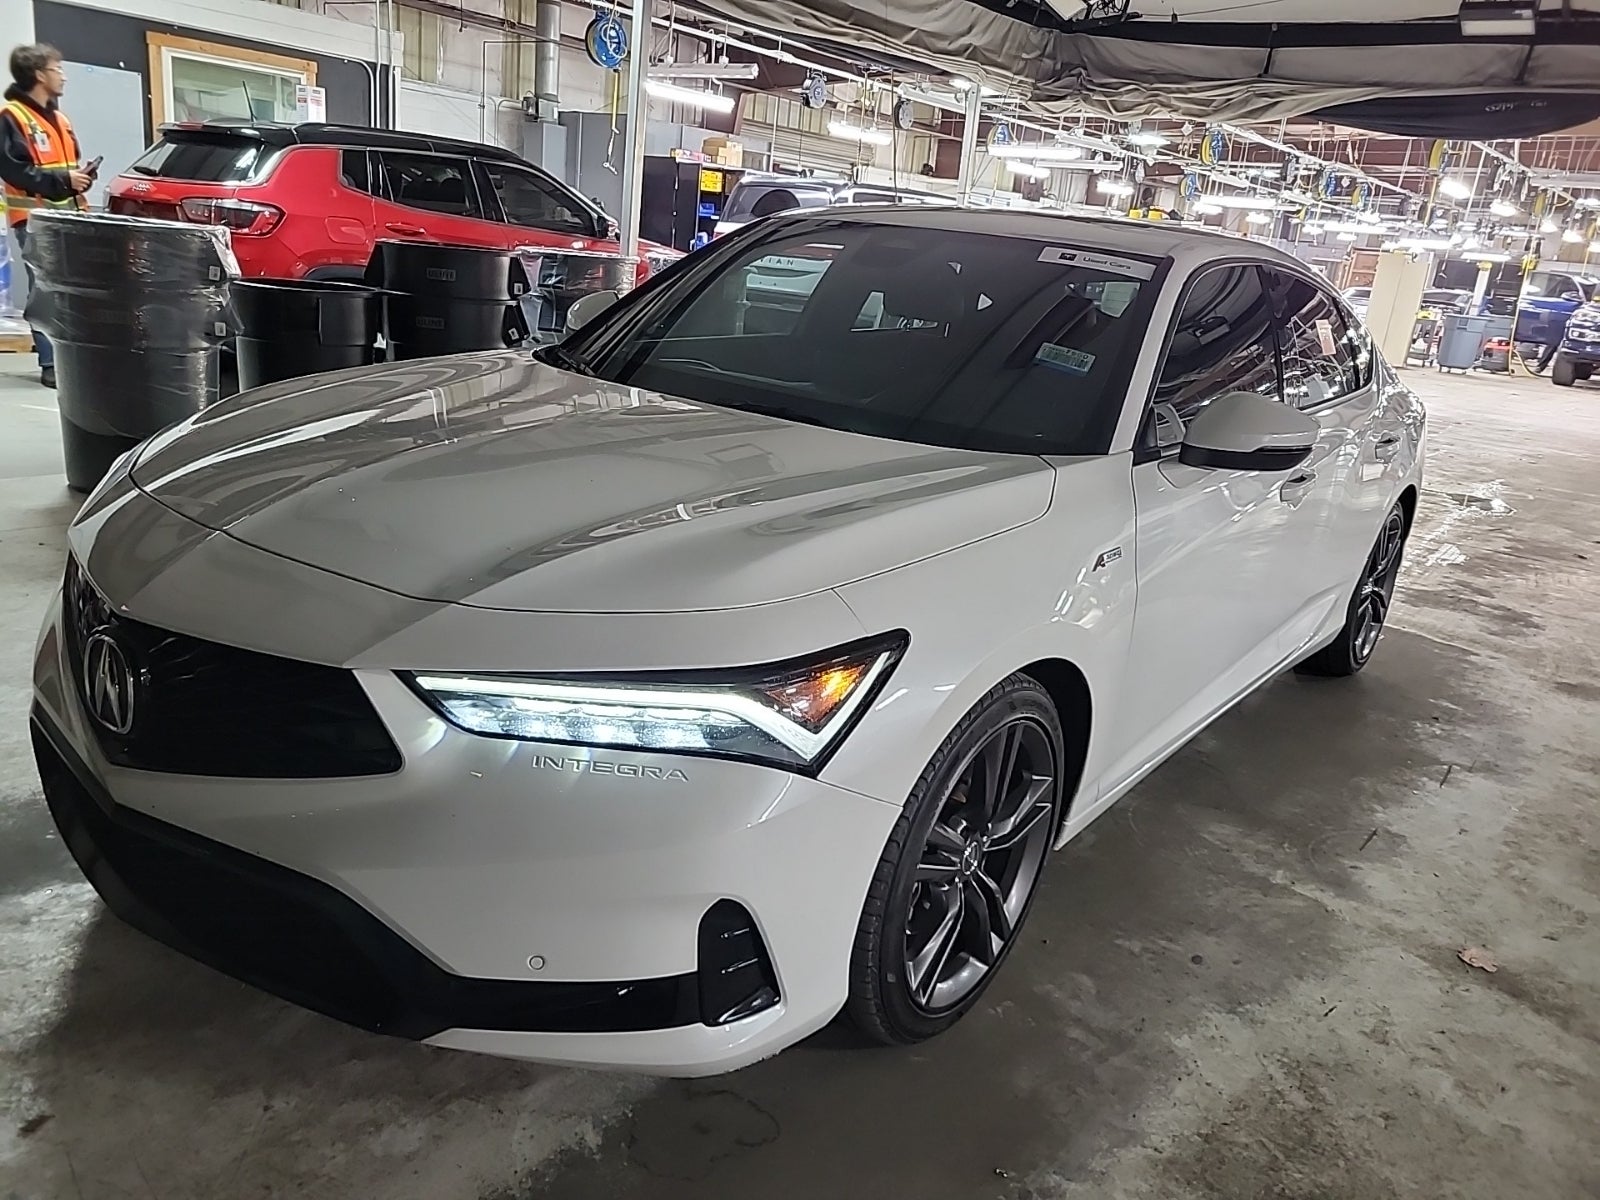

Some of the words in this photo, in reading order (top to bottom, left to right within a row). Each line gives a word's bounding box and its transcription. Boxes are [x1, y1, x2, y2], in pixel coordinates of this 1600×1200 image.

[1083, 256, 1108, 265] Used
[1109, 261, 1132, 270] Cars
[532, 755, 689, 783] INTEGRA
